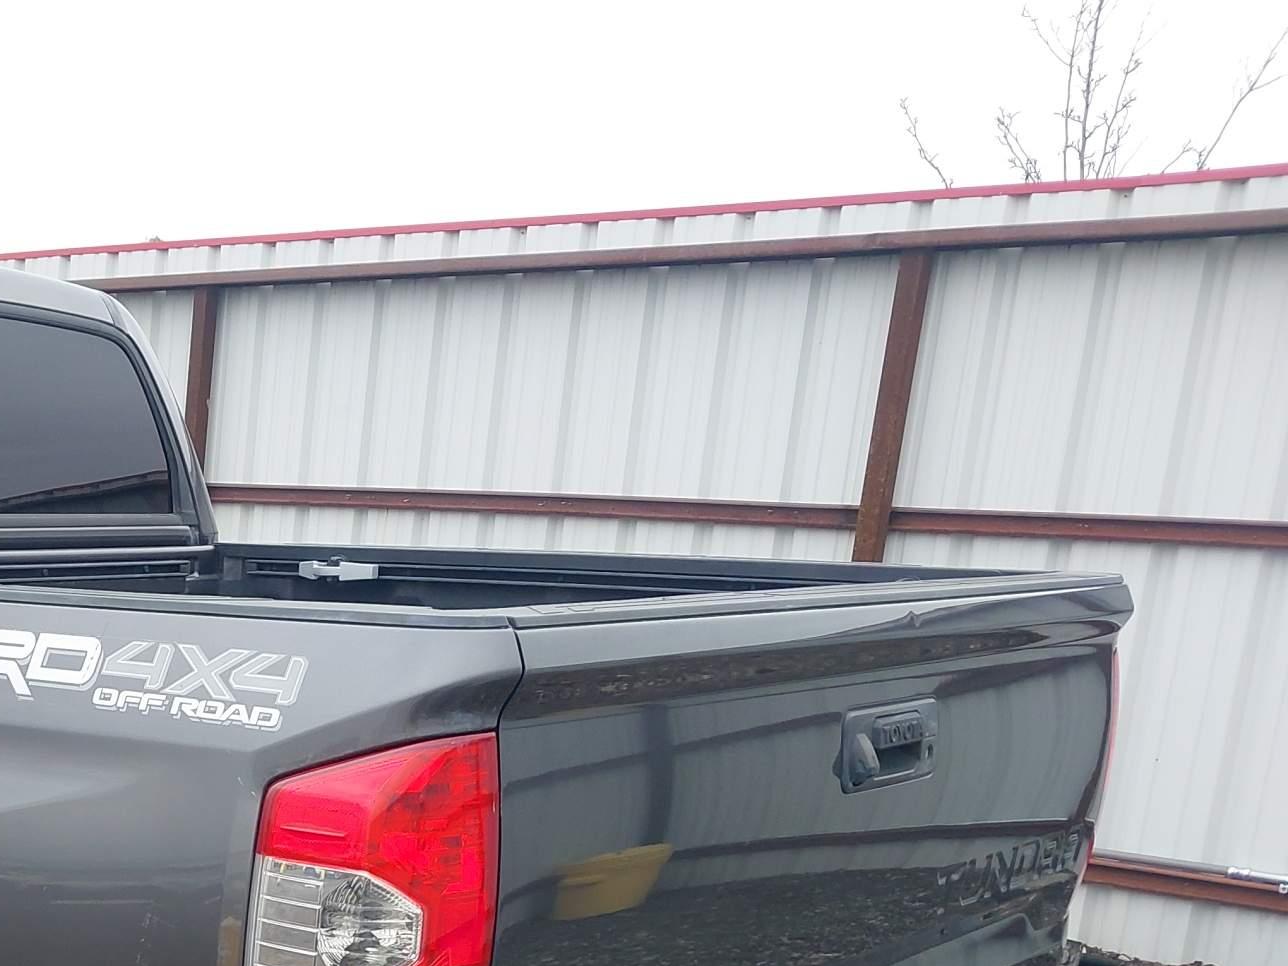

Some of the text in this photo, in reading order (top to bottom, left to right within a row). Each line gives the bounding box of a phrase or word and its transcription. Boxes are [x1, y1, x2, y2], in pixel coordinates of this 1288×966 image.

[103, 639, 311, 706] 4X4
[91, 687, 284, 732] OFF ROAD
